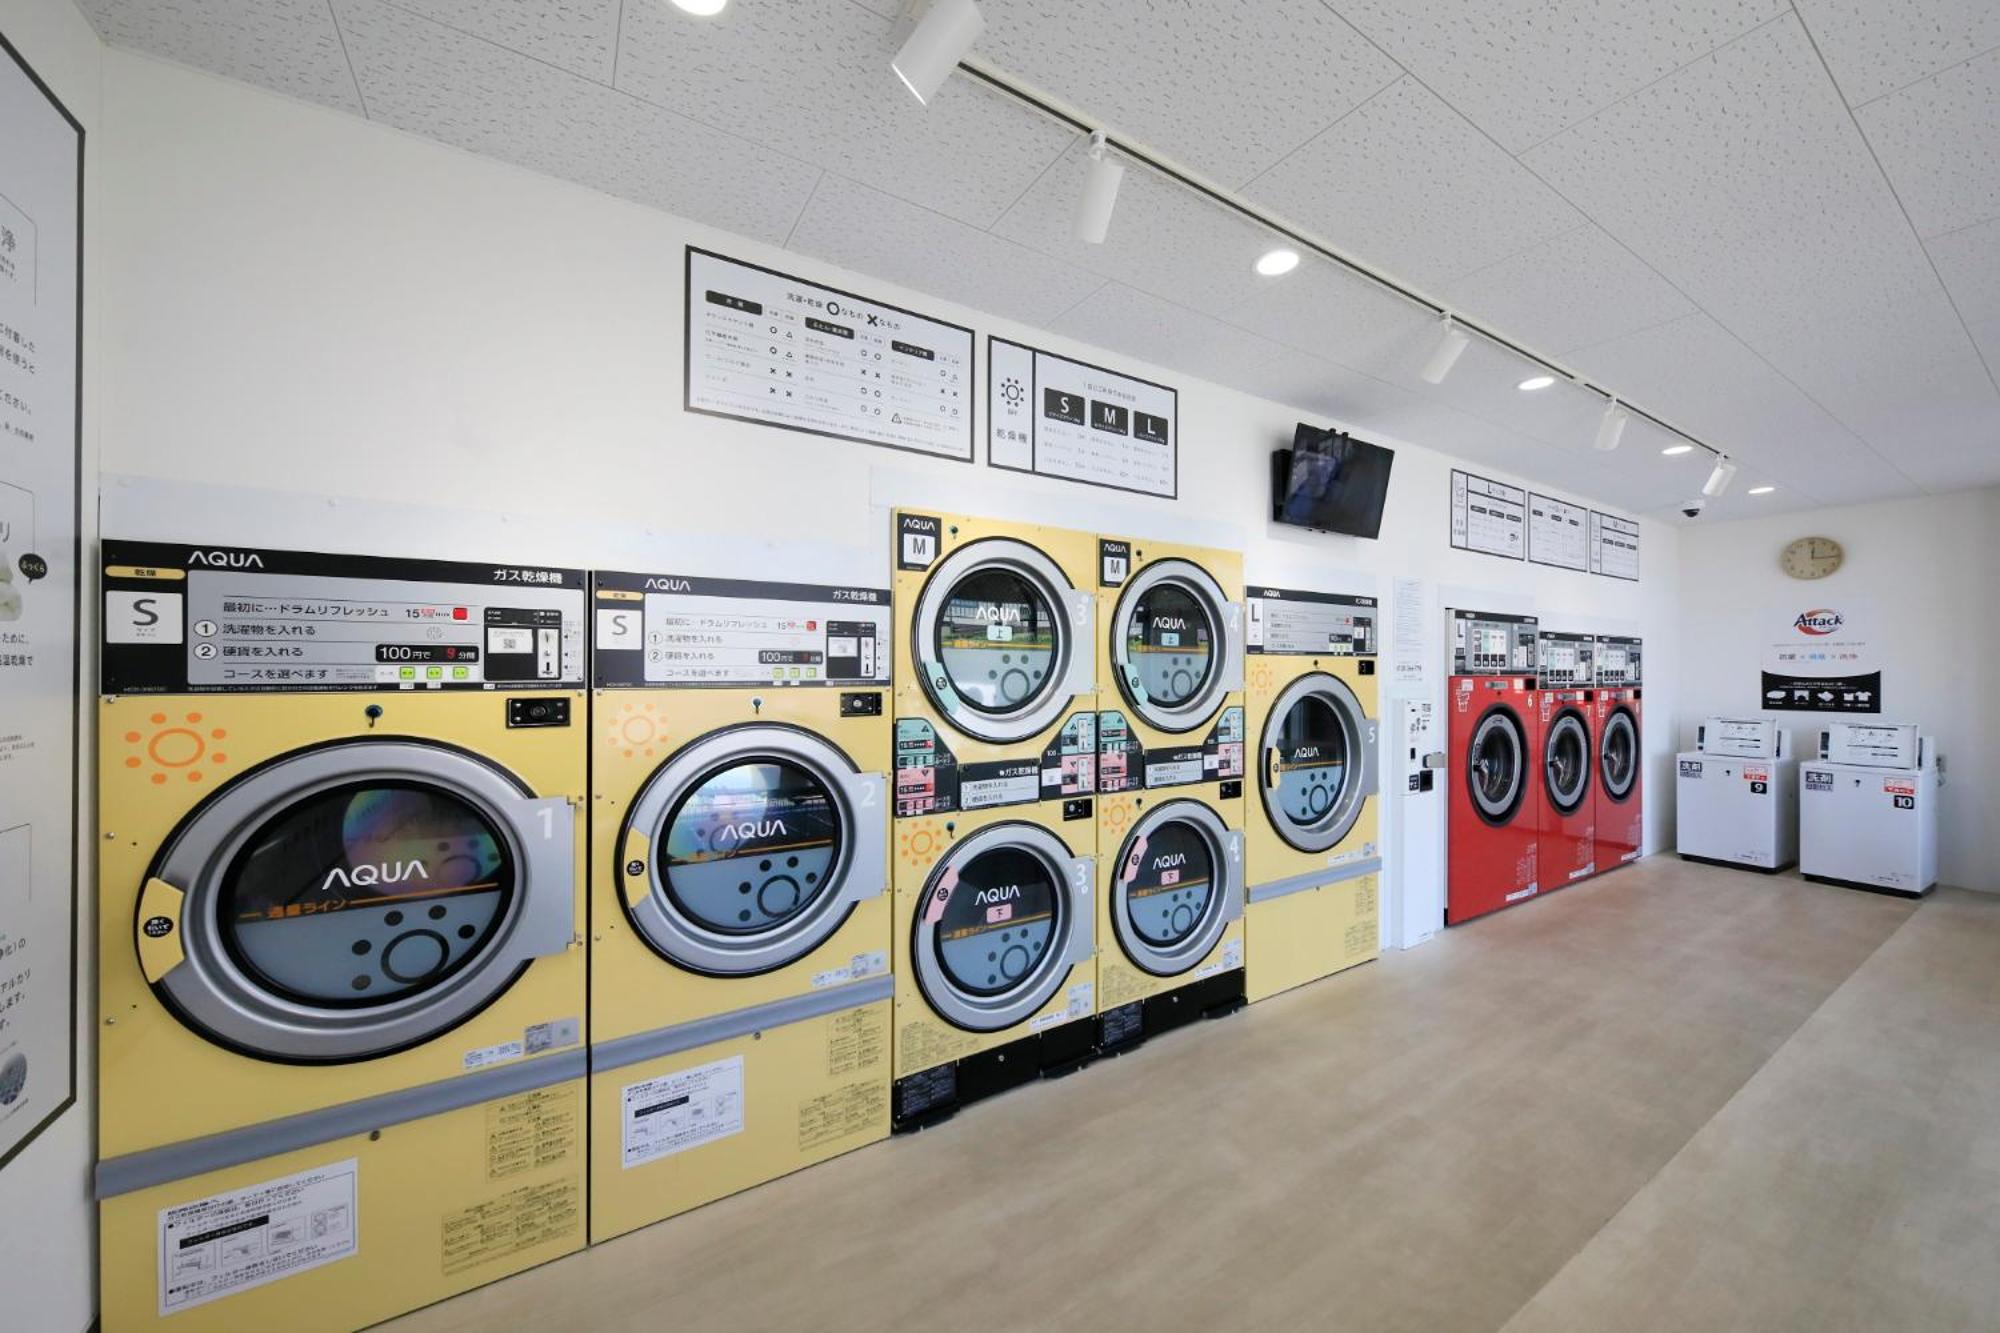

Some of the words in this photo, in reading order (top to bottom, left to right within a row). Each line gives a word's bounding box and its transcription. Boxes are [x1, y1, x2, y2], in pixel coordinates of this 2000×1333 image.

[1060, 397, 1070, 413] S
[1103, 407, 1116, 425] M
[1147, 418, 1156, 435] L
[903, 518, 936, 531] AQUA
[912, 537, 926, 550] M
[1103, 543, 1127, 553] AQUA
[188, 550, 265, 568] AQUA
[1110, 559, 1120, 574] M
[493, 568, 563, 584] ガス乾燥機
[644, 578, 691, 591] AQUA
[1263, 589, 1281, 598] AQUA
[132, 598, 159, 627] S
[974, 605, 1021, 622] AQUA
[1251, 603, 1260, 622] L
[611, 614, 628, 636] S
[1152, 616, 1186, 630] AQUA
[1793, 613, 1844, 628] Attack
[222, 623, 316, 636] 洗濯物を入れる
[222, 646, 304, 657] 硬貨を入れる
[223, 669, 329, 680] コースを選べます
[1293, 746, 1320, 758] AQUA
[860, 781, 876, 808] 2
[1754, 783, 1764, 792] 9
[1896, 797, 1912, 808] 10
[536, 806, 554, 841] 1
[719, 819, 788, 842] AQUA
[1152, 853, 1186, 870] AQUA
[322, 859, 429, 890] AQUA
[1075, 863, 1087, 887] 3
[974, 884, 1021, 906] AQUA
